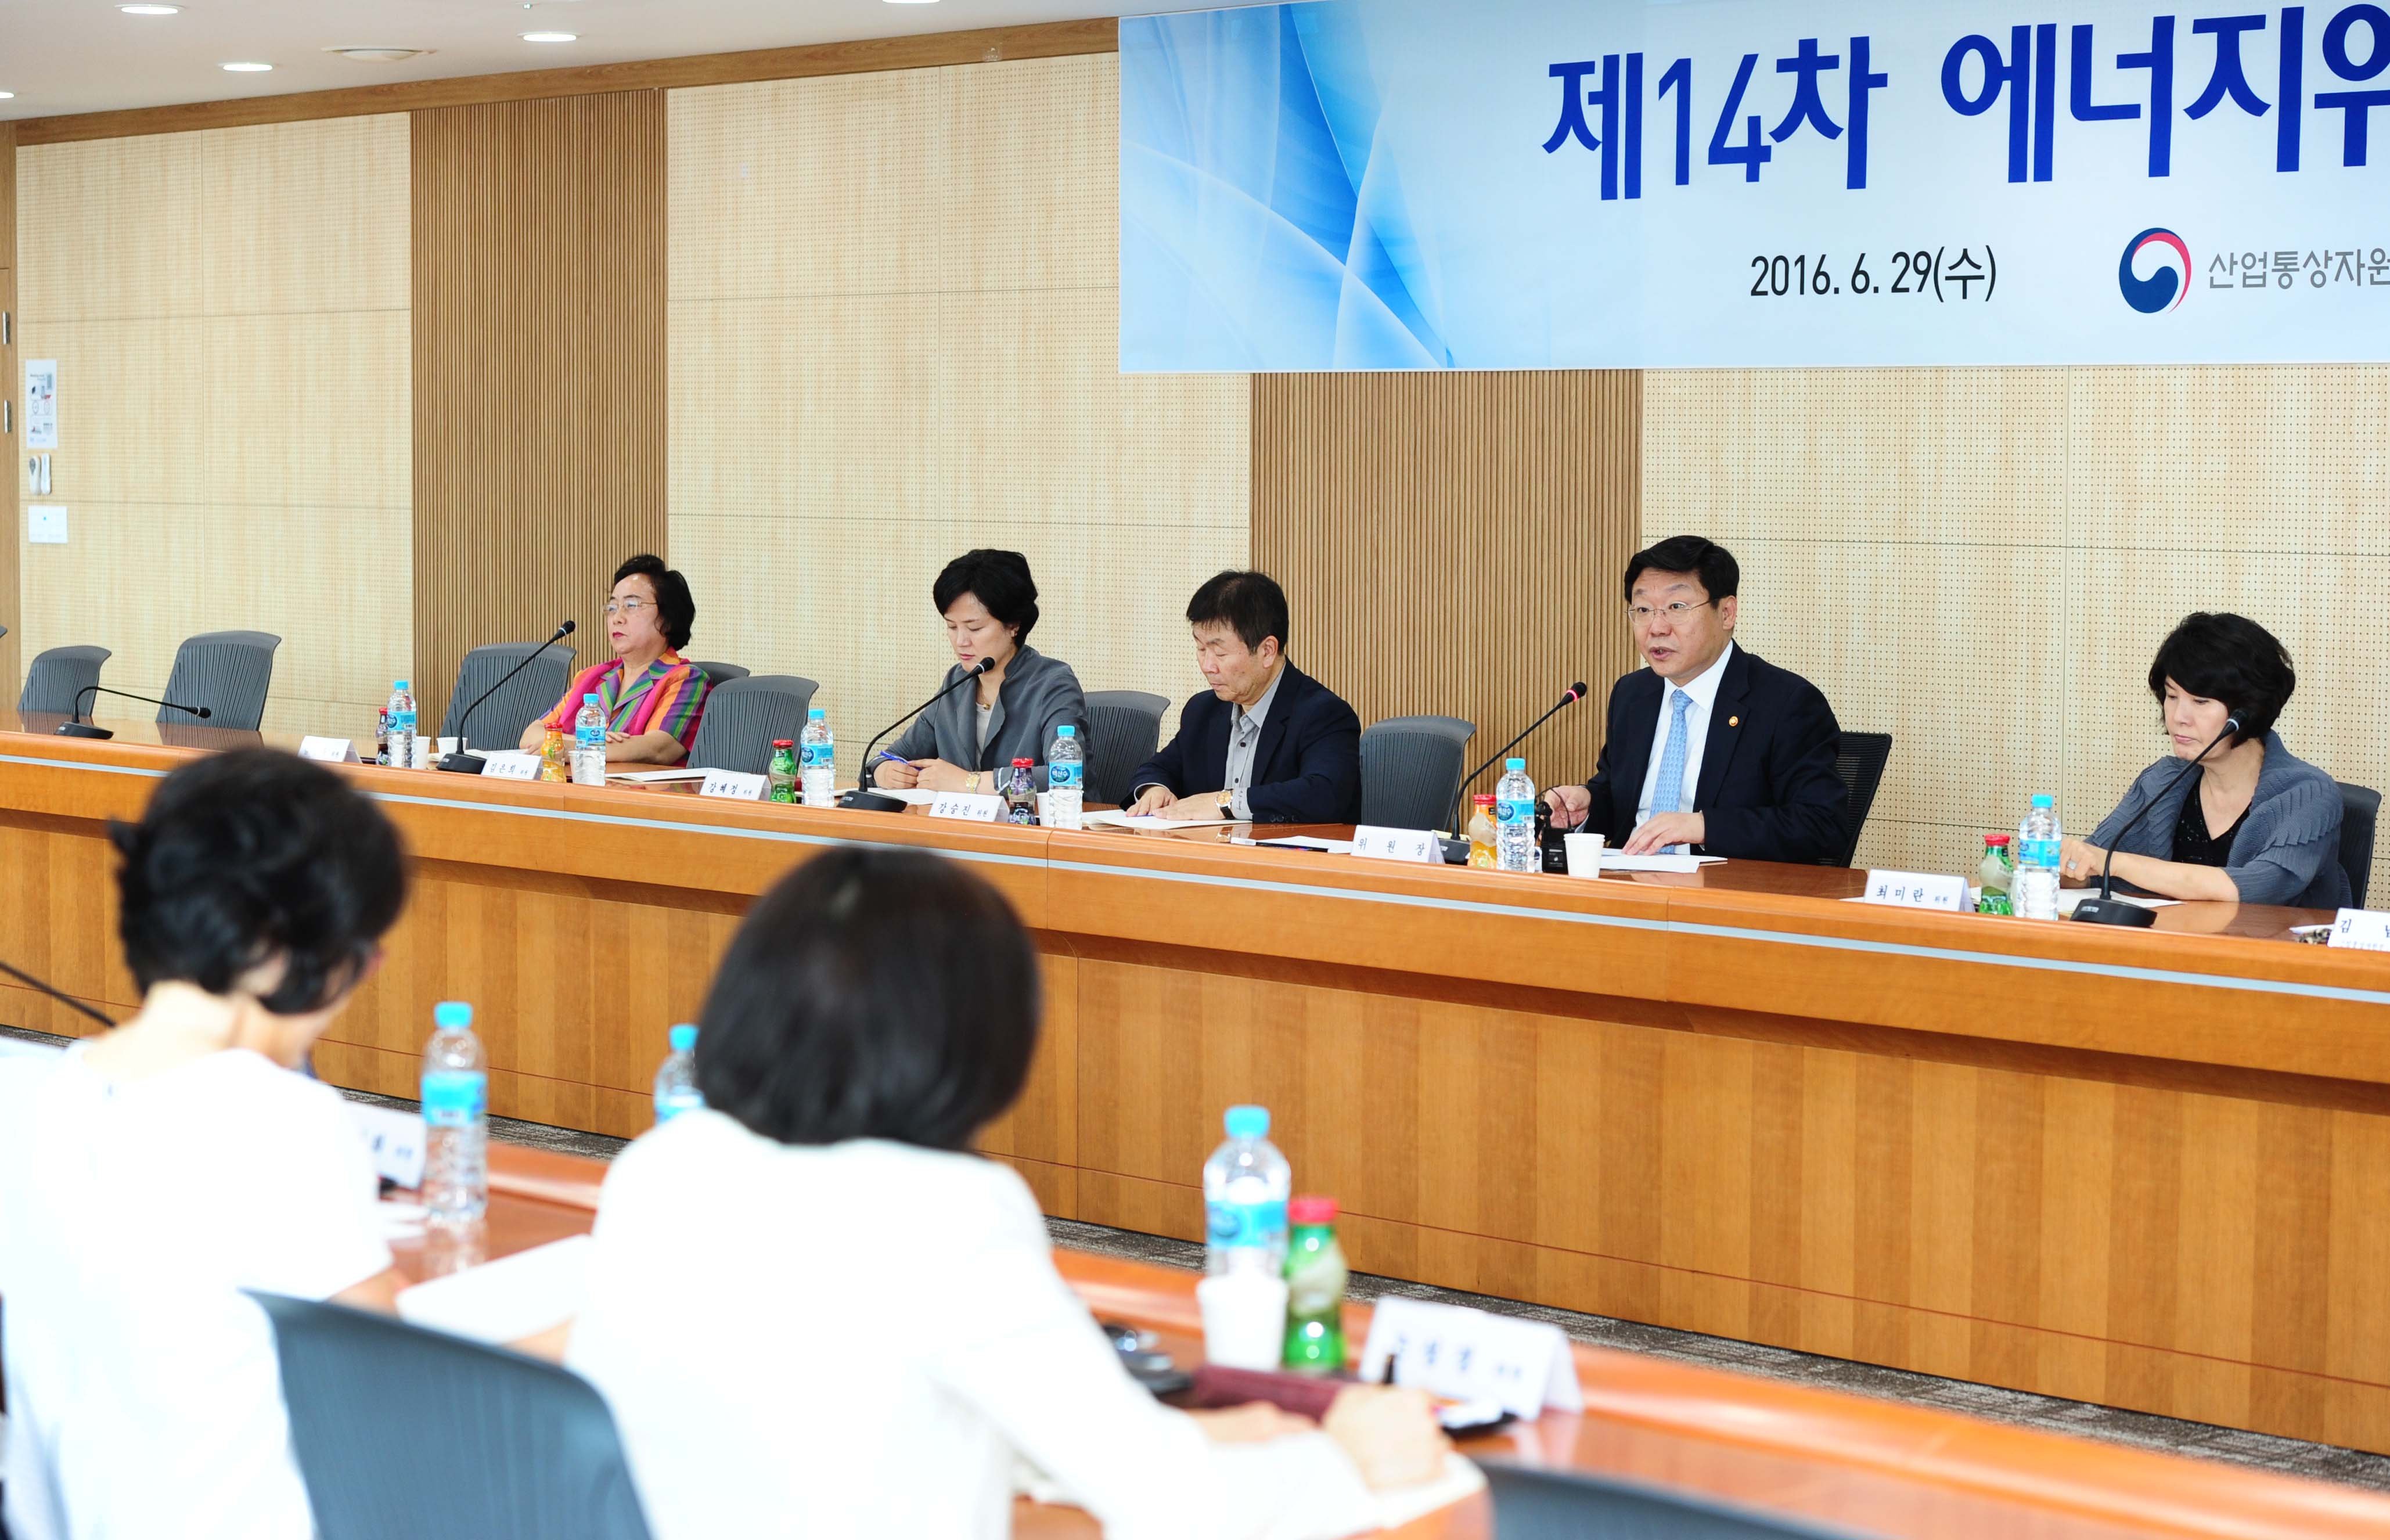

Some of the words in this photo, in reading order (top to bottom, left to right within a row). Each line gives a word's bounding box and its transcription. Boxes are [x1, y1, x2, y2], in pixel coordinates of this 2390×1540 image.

[1542, 37, 1888, 200] 제14차
[1751, 253, 1840, 298] 2016.
[1851, 251, 1878, 294] 6.
[1891, 245, 1996, 303] 29(수)
[2208, 248, 2390, 290] 산업통상자원
[938, 802, 971, 816] 강승진
[1877, 884, 1924, 902] 최미란
